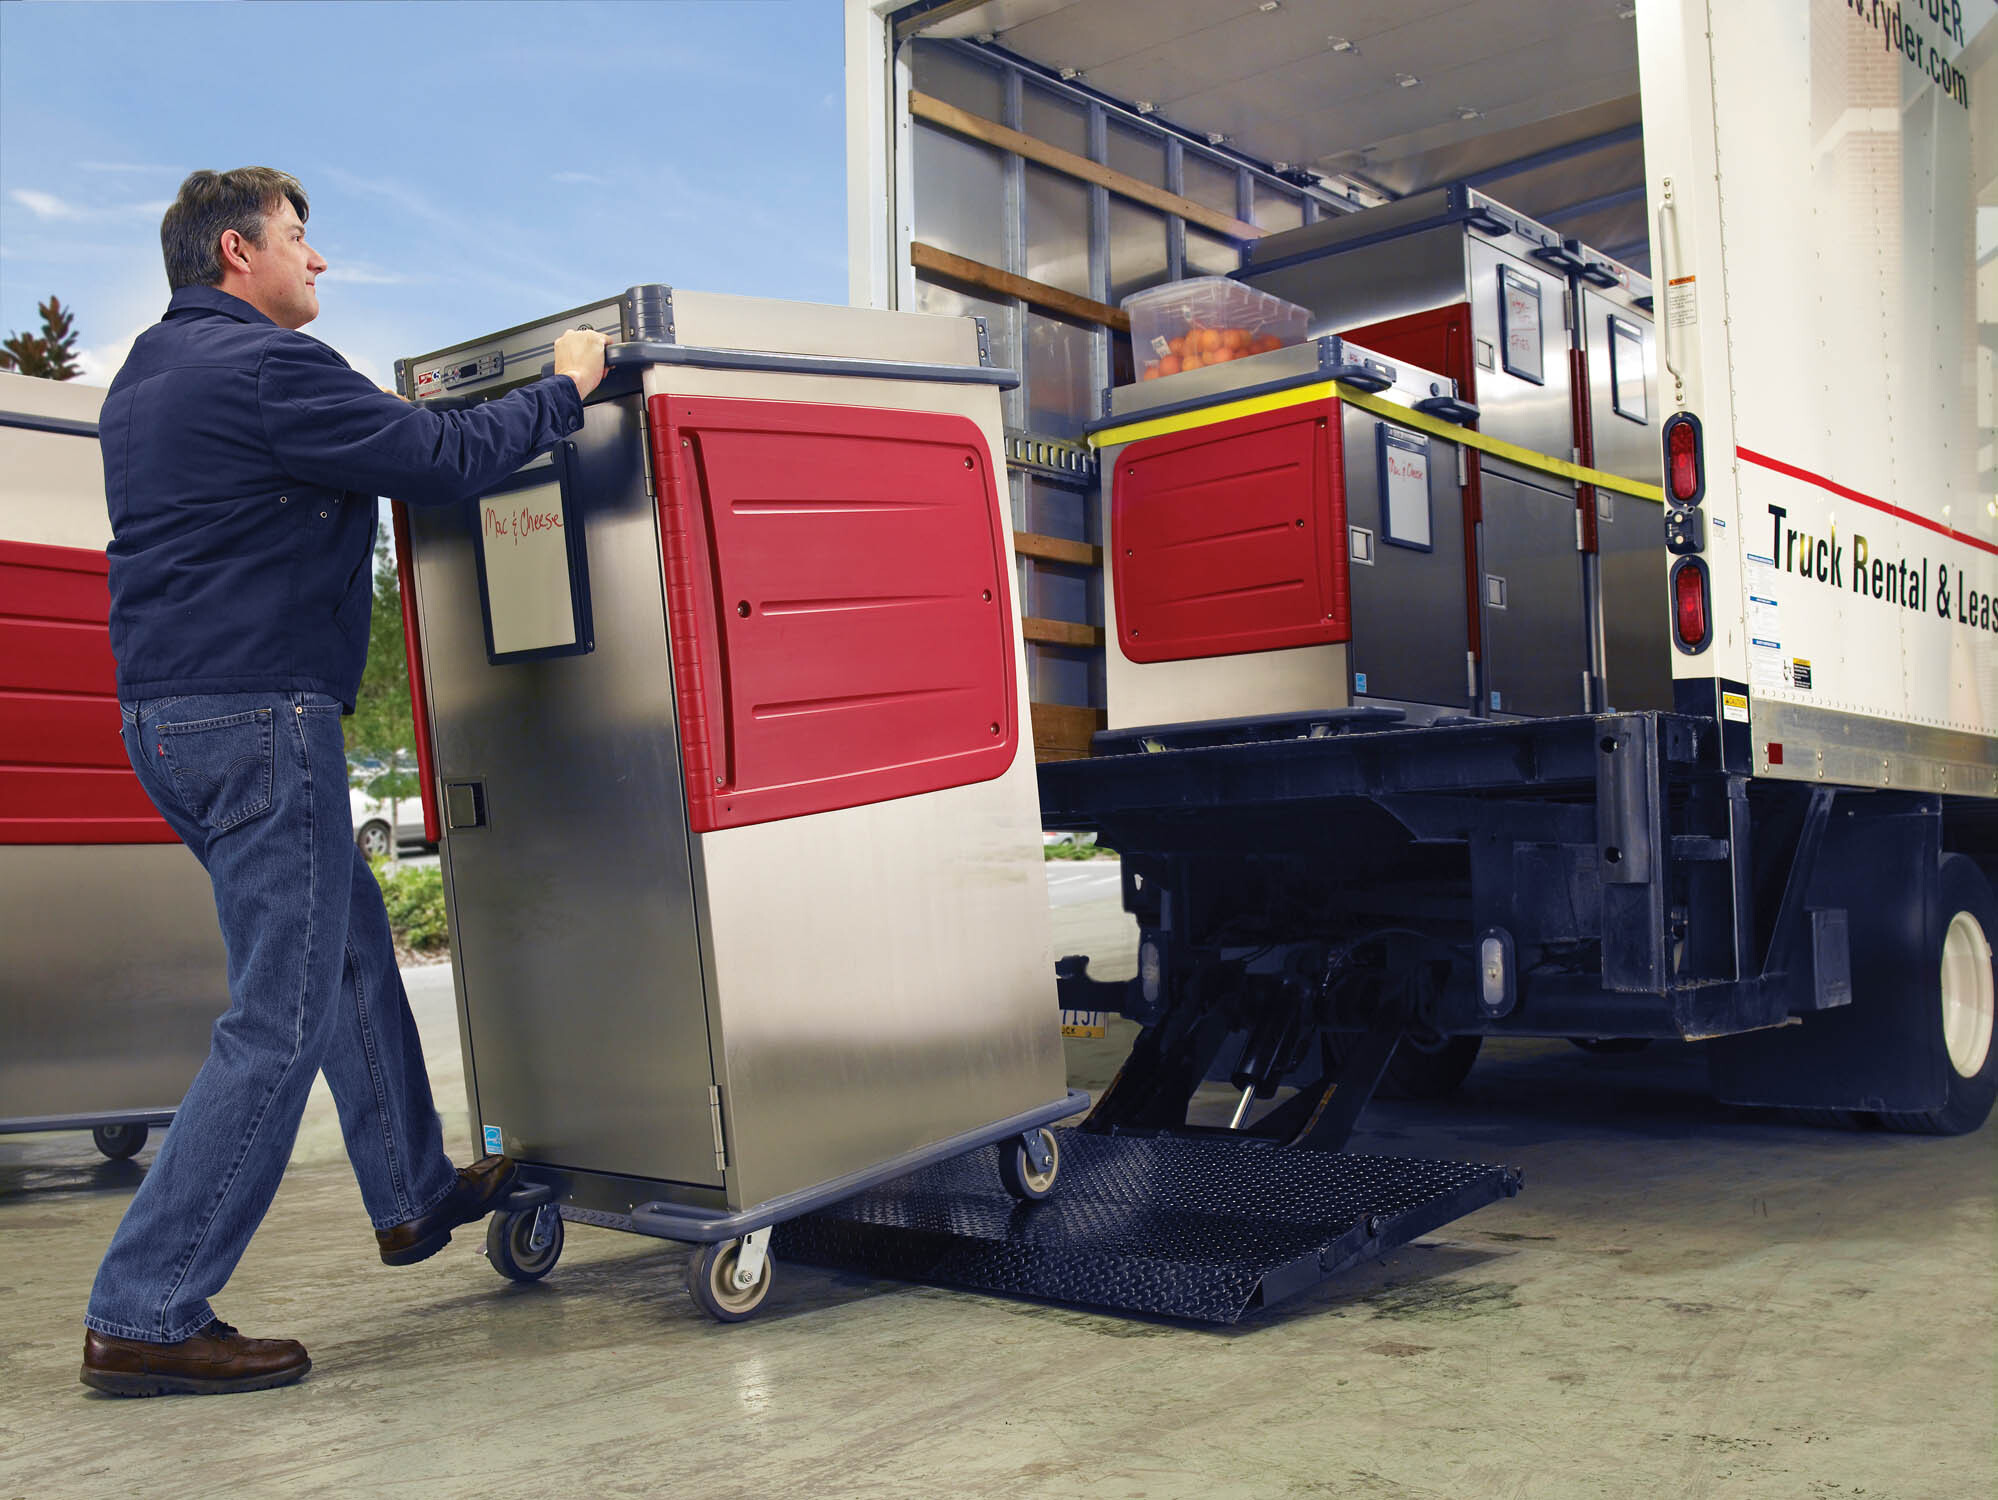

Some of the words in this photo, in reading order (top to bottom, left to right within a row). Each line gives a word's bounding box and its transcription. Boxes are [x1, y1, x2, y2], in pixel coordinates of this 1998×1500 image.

[485, 507, 508, 538] Mac
[512, 509, 518, 546] &
[520, 506, 564, 537] Cheese
[1768, 503, 1843, 589] Truck
[1853, 534, 1928, 613] Rental
[1936, 564, 1951, 619] &
[1958, 570, 1998, 634] Leas
